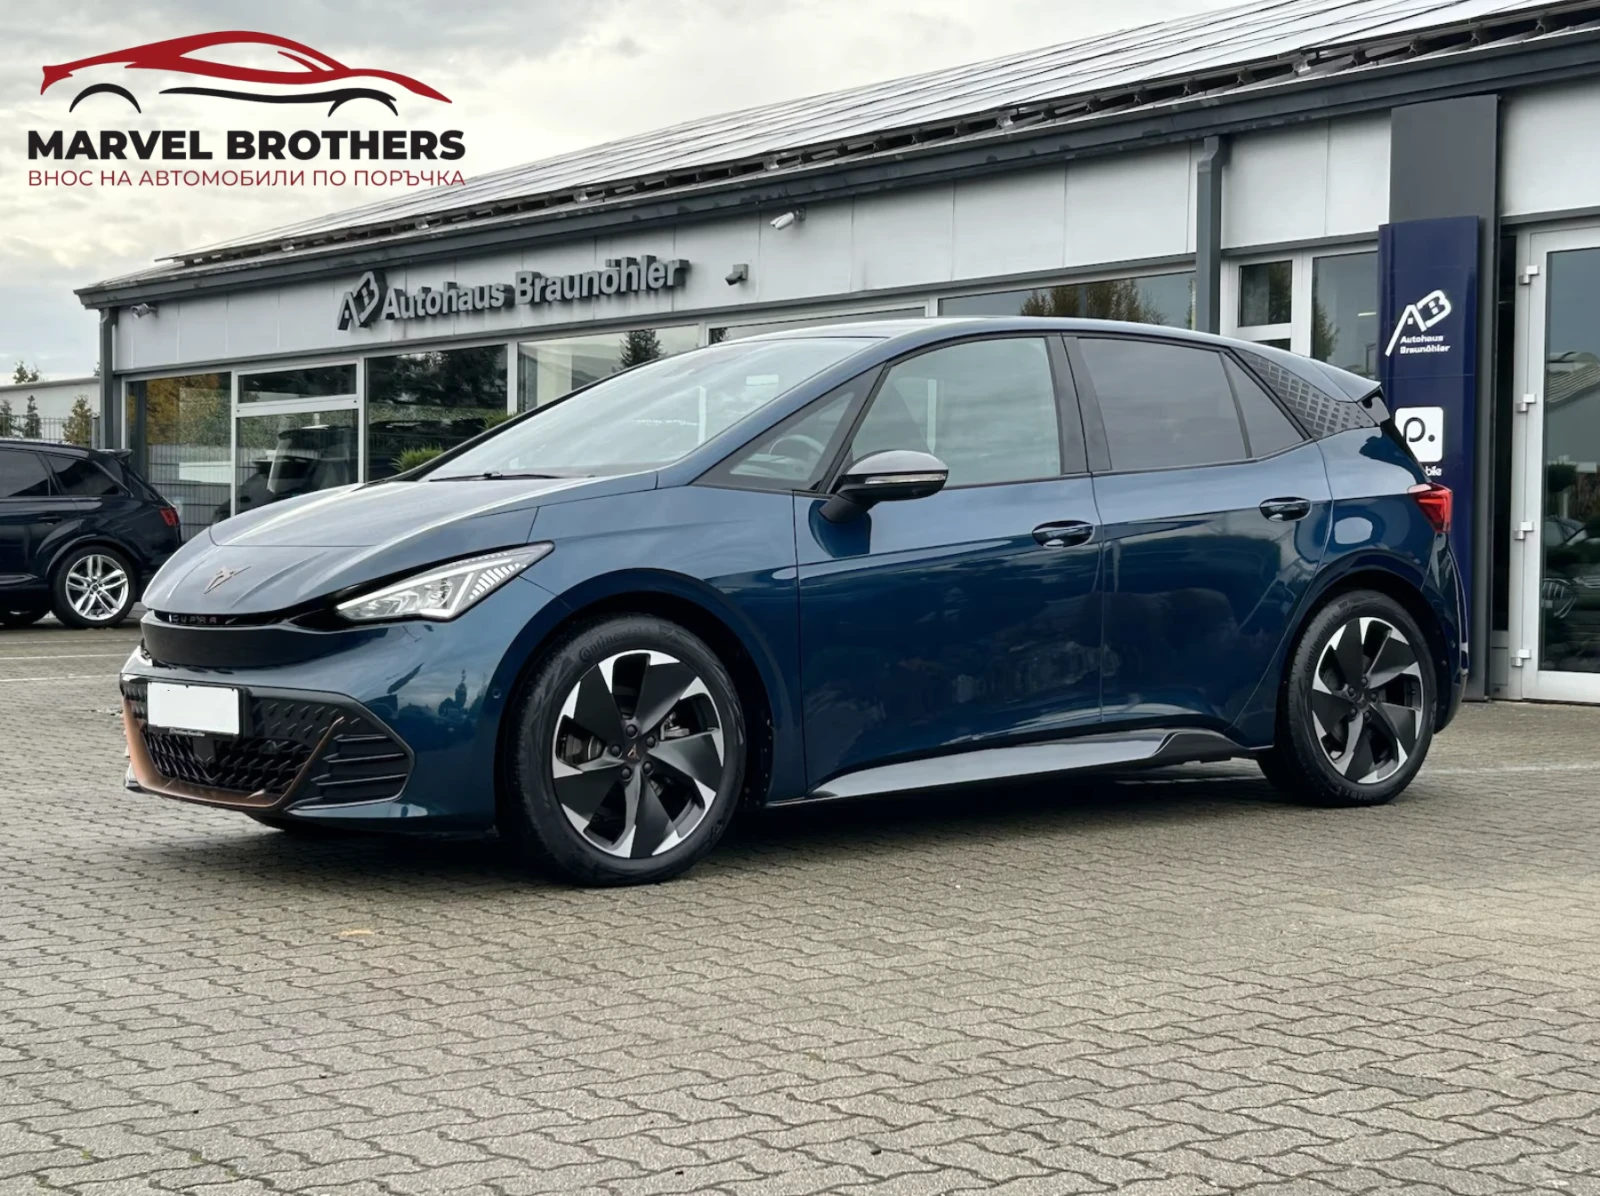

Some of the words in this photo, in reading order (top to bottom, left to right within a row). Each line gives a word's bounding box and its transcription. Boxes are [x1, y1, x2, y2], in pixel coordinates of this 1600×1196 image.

[380, 281, 515, 321] Autohaus
[515, 255, 690, 305] Braunöhler
[1400, 335, 1443, 344] Autohaus
